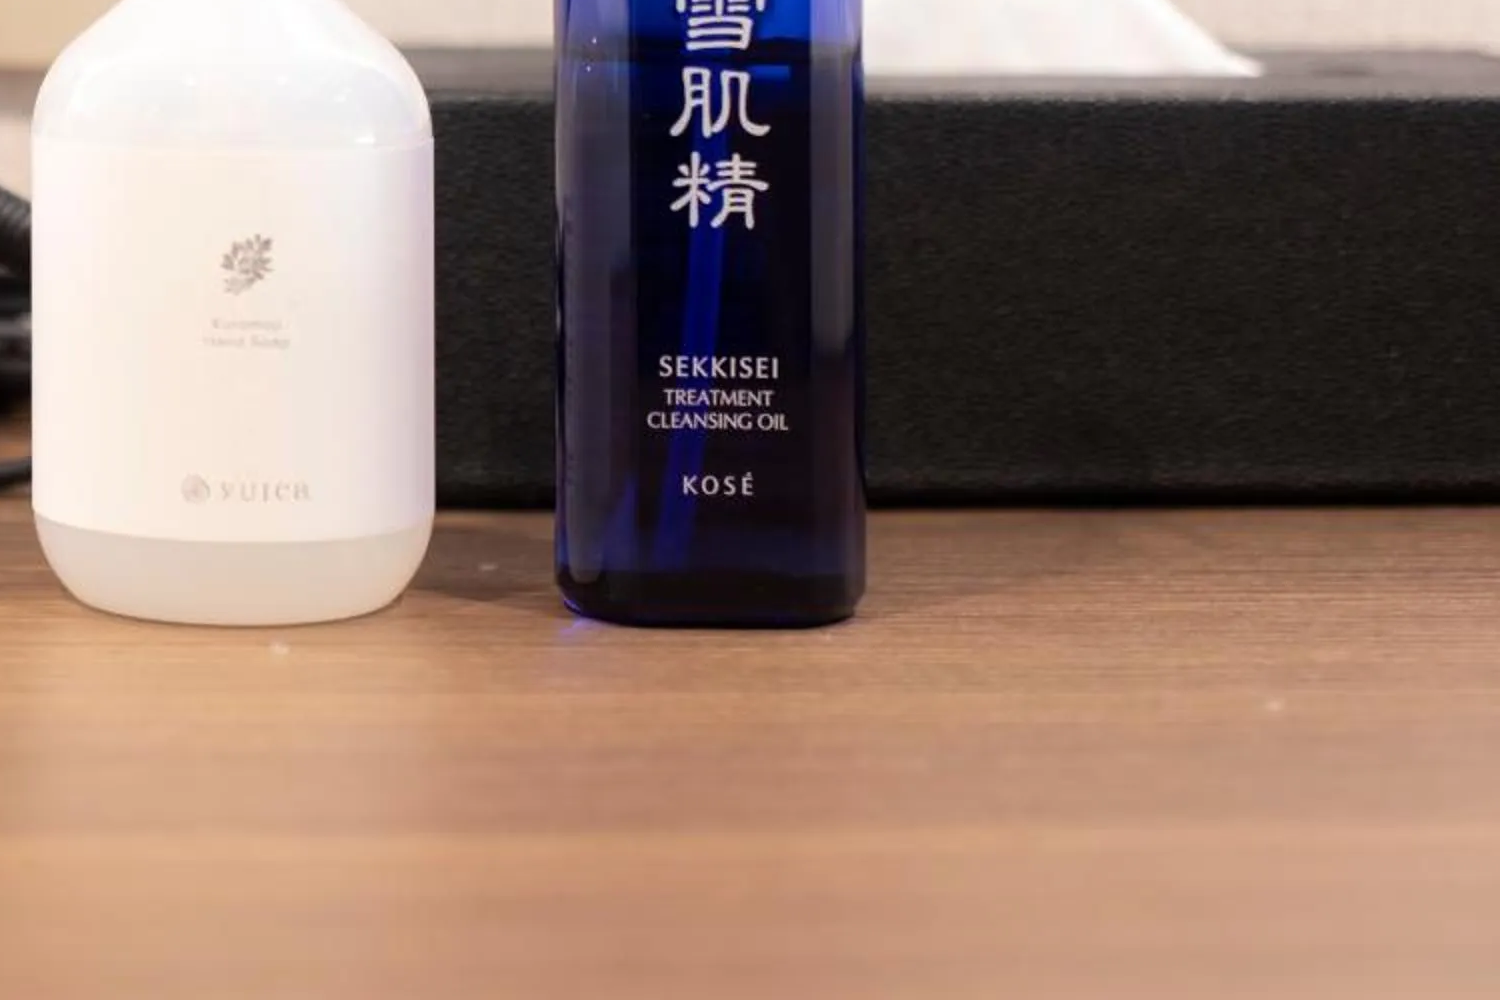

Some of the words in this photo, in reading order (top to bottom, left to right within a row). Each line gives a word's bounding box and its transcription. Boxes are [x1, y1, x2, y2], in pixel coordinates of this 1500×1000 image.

[658, 355, 779, 379] SEKKISEI
[663, 388, 774, 407] TREATMENT
[646, 411, 753, 430] CLEANSING
[756, 413, 789, 431] OIL
[682, 471, 755, 496] KOSÉ
